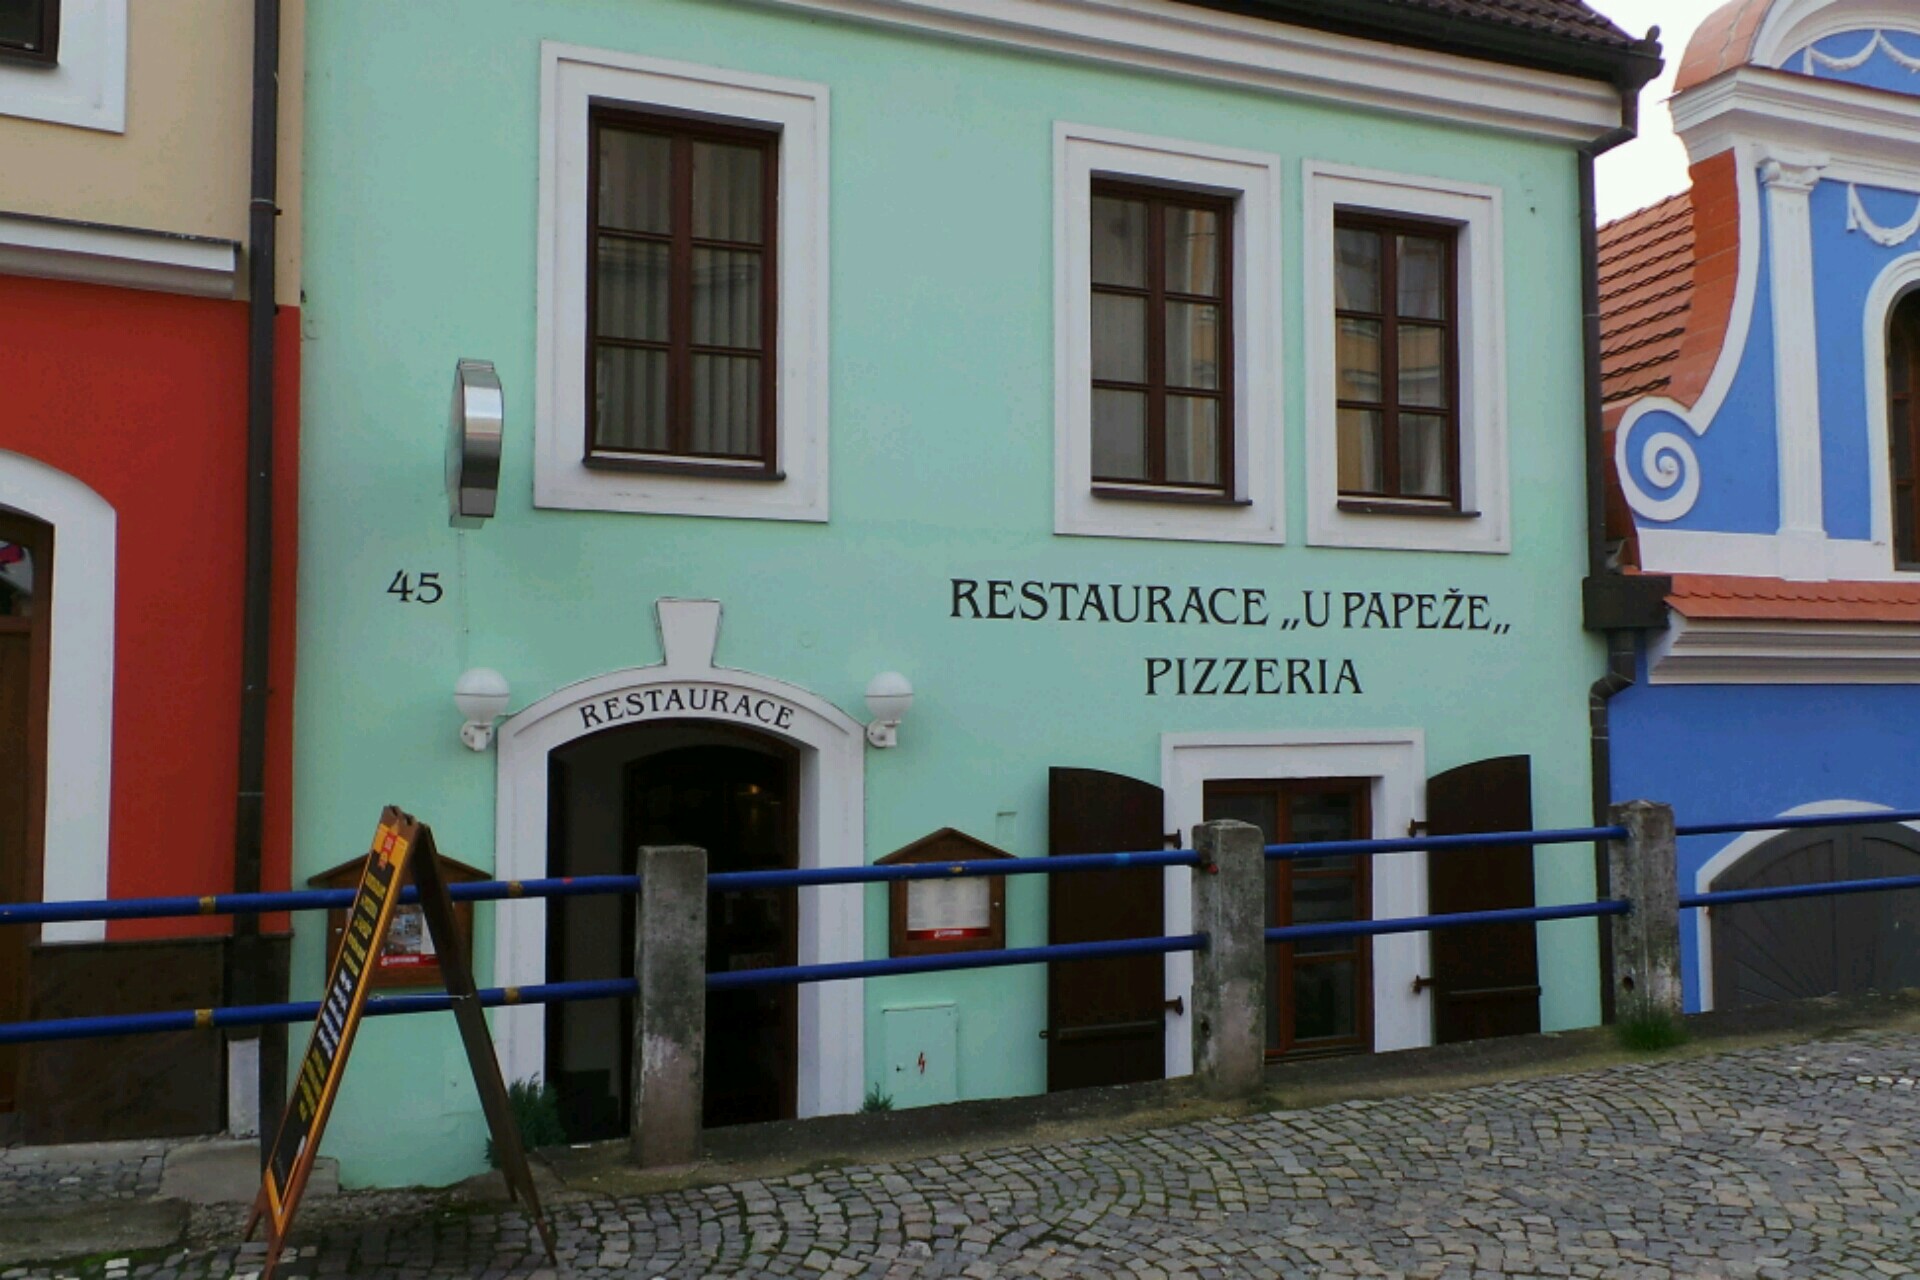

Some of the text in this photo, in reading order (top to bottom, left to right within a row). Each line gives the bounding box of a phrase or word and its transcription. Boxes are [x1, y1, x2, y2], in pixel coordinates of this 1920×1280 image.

[386, 569, 443, 604] 45
[950, 578, 1269, 626] RESTAURACE
[1145, 657, 1363, 696] PIZZERIA
[579, 687, 795, 730] RESTAURACE
